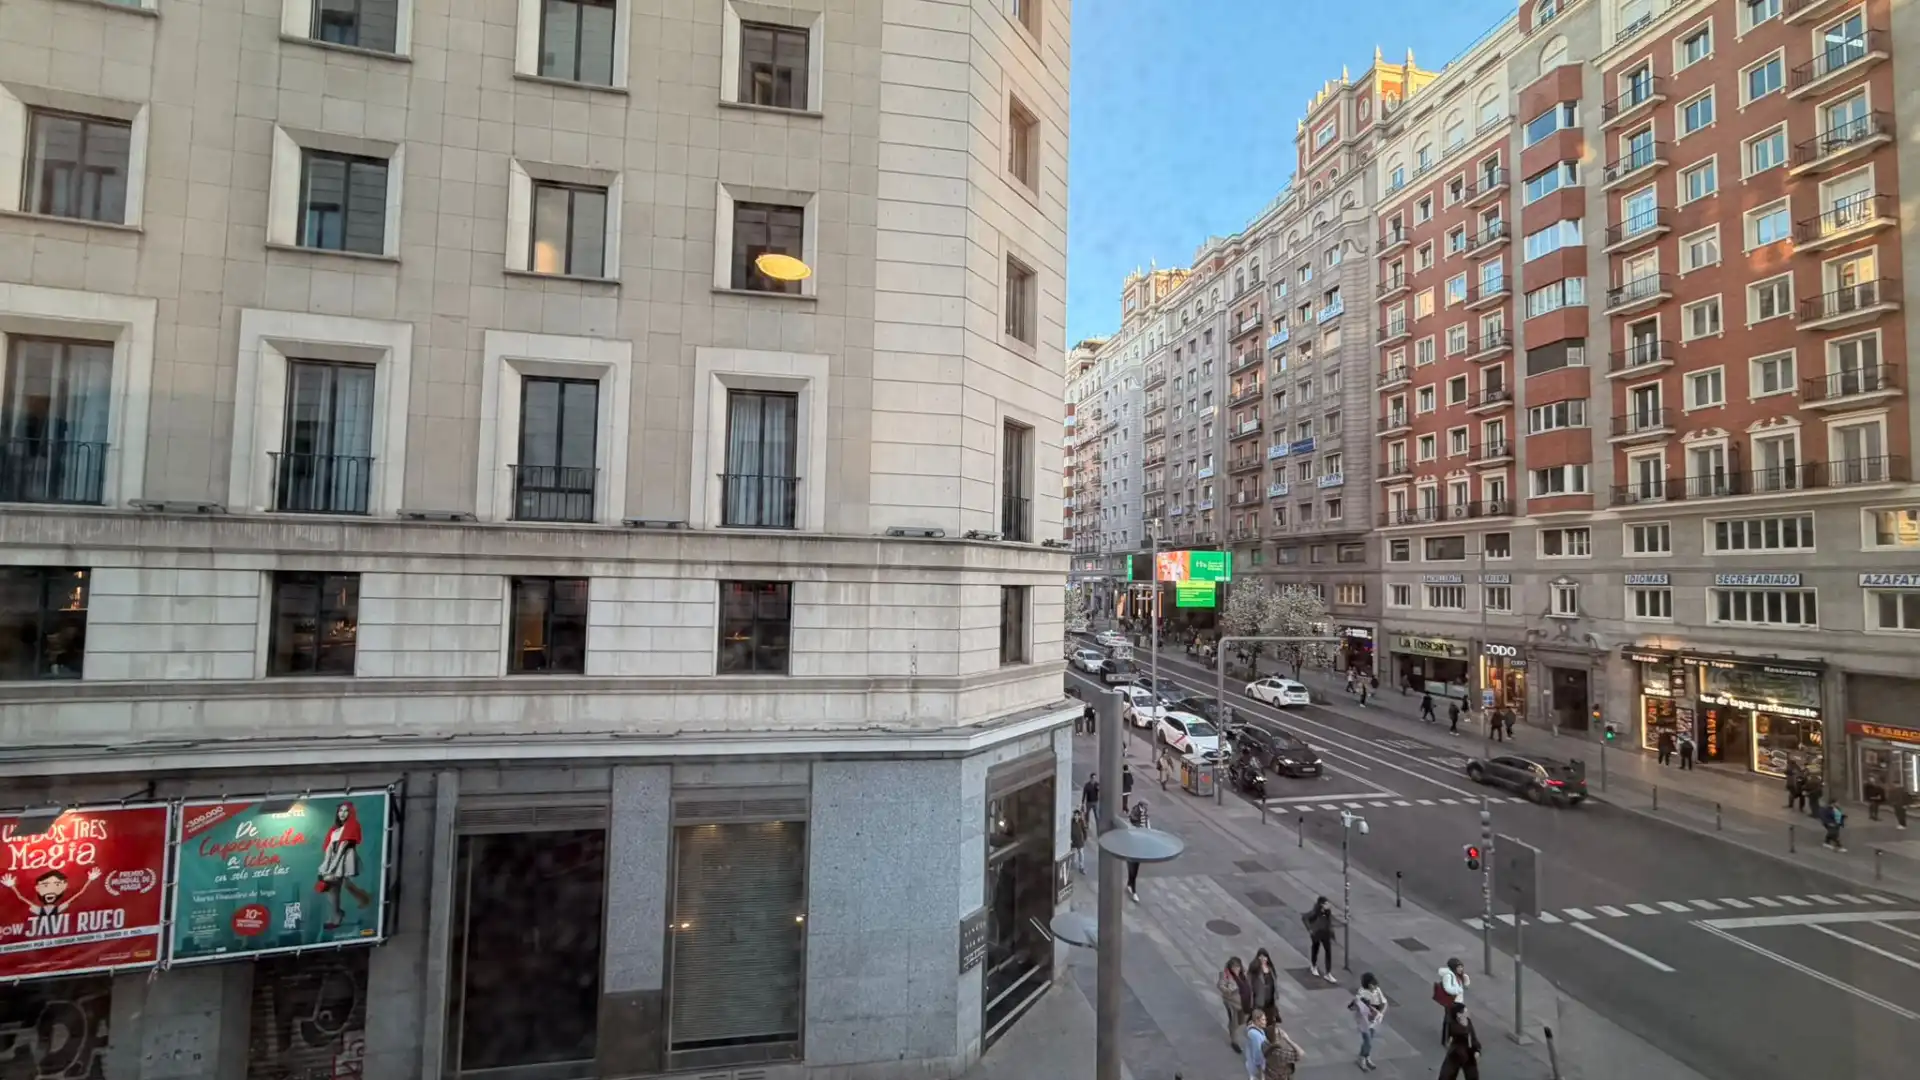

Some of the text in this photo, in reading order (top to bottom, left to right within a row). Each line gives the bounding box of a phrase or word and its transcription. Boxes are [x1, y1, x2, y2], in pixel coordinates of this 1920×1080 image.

[1626, 574, 1666, 584] IDIOMAS
[1717, 573, 1798, 585] SECRETARIADO
[1862, 573, 1920, 585] AZAFAT
[1716, 696, 1728, 705] de
[1730, 697, 1756, 709] tapas
[1758, 703, 1818, 718] restaurante
[70, 817, 108, 840] TRES
[235, 819, 260, 839] De
[198, 826, 306, 860] Caperucita
[8, 841, 96, 871] Magia
[25, 913, 70, 937] JAVI
[77, 907, 126, 933] RUFO
